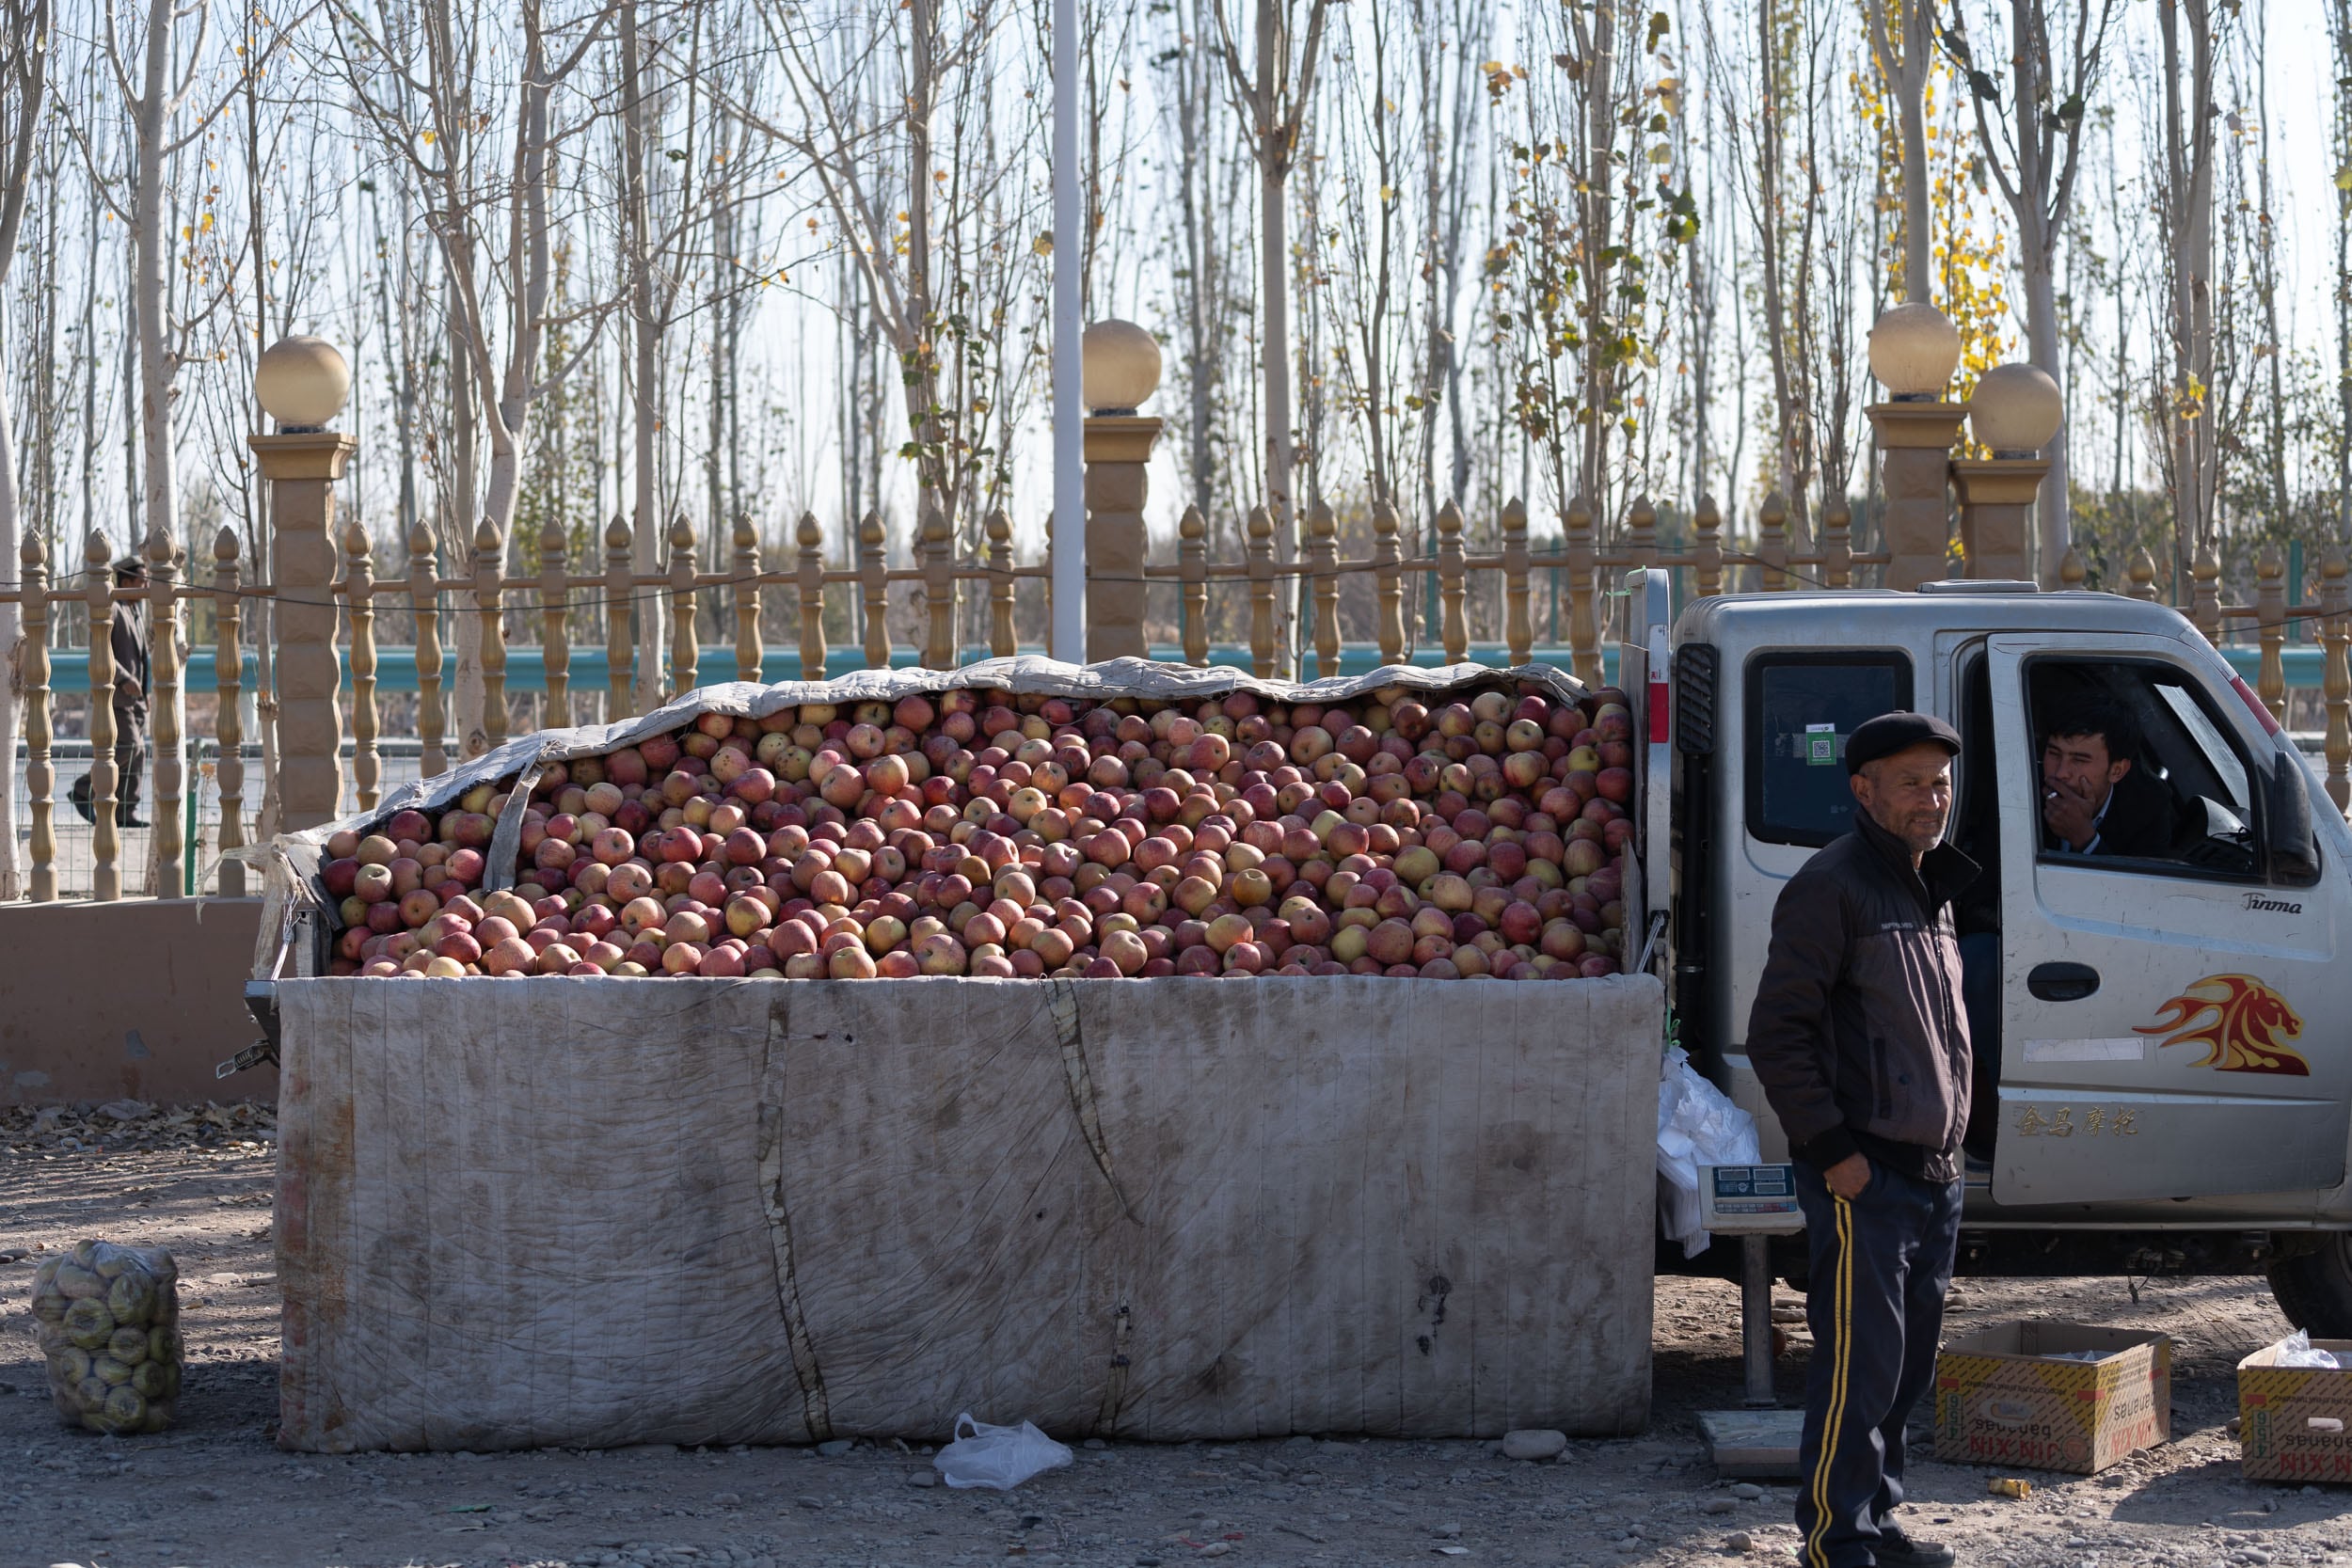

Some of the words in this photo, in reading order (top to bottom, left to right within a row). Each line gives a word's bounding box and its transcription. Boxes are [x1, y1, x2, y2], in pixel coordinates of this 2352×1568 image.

[2017, 1105, 2138, 1136] 金马摩托
[1969, 1434, 2012, 1457] XIN
[2020, 1439, 2058, 1461] JIN
[2280, 1451, 2325, 1475] XIN
